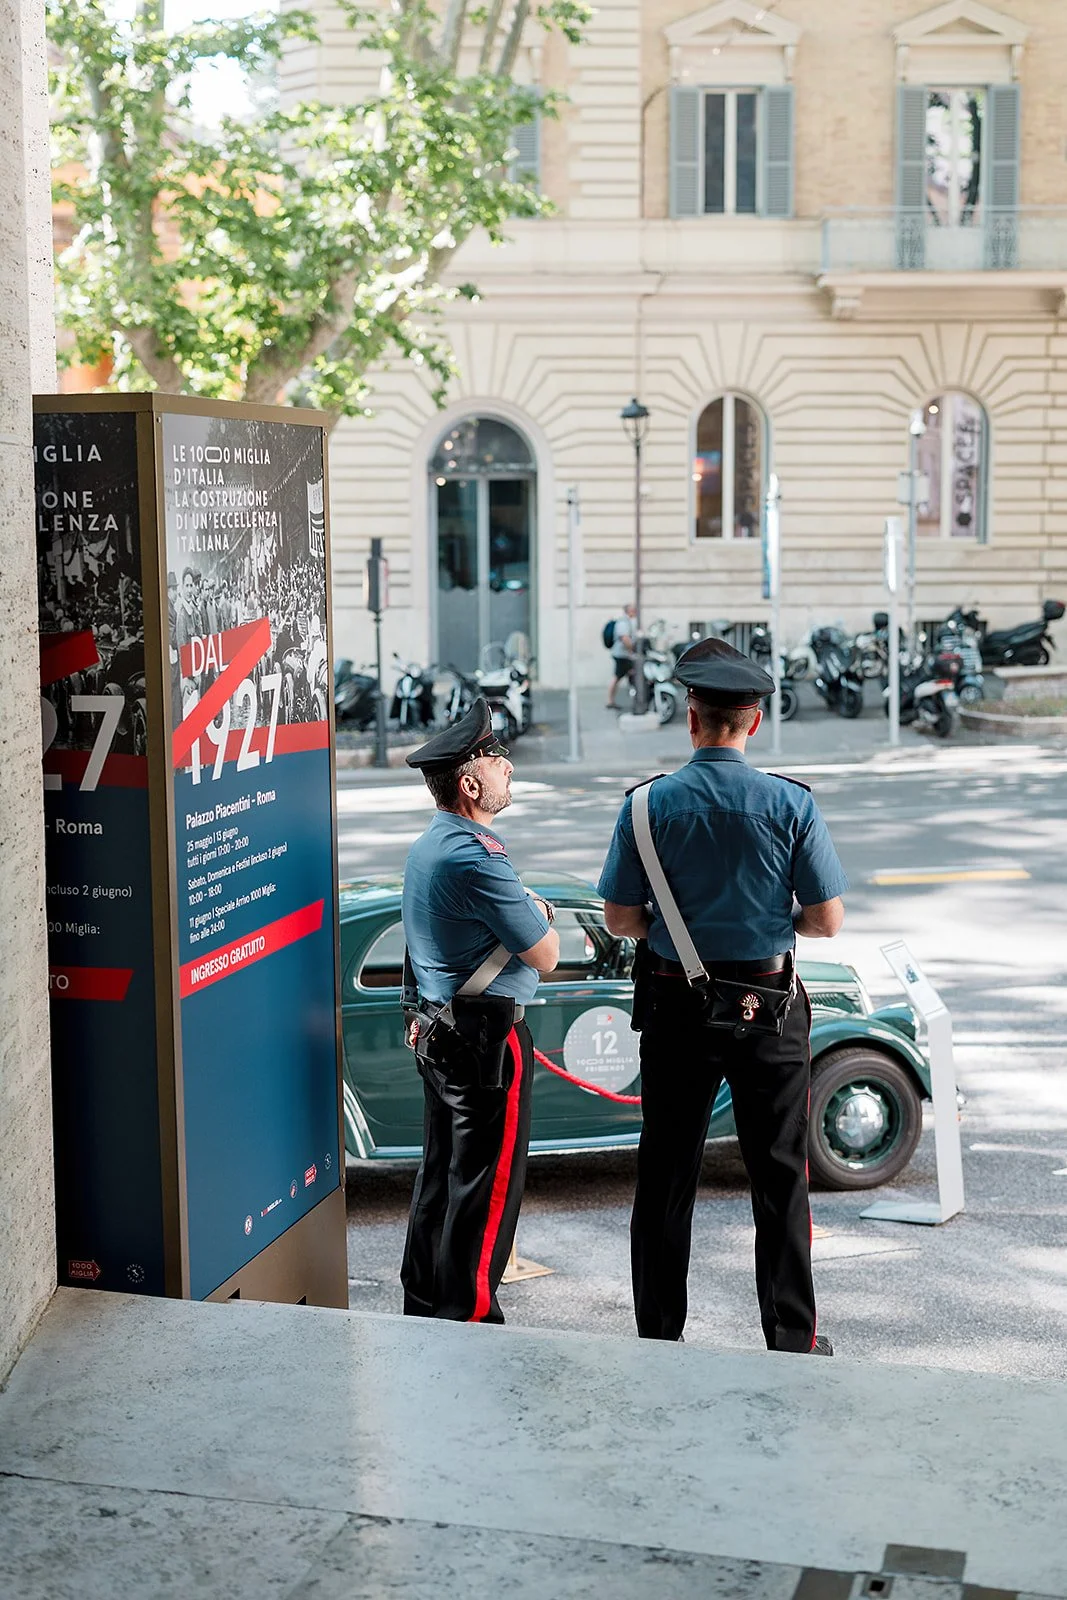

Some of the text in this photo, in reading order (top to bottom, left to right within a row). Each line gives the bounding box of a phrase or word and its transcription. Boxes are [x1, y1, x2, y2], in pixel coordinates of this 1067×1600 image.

[173, 445, 186, 463] LE
[235, 448, 271, 465] MIGLIA
[174, 468, 225, 485] D'ITALIA
[42, 491, 94, 508] ONE
[175, 490, 269, 508] LA COSTRUZIONE
[39, 514, 119, 531] LENZA
[176, 511, 278, 530] DI UN'ECCELLENZA
[177, 534, 230, 553] ITALIANA
[191, 633, 229, 677] DAL
[183, 673, 282, 786] 1927
[186, 809, 215, 830] Palazzo
[215, 794, 250, 820] Piacentini
[257, 790, 276, 806] Roma
[55, 819, 103, 835] Roma
[187, 854, 199, 868] tutti
[203, 848, 217, 865] giorni
[207, 866, 231, 882] Domenica
[232, 865, 235, 873] e
[82, 885, 89, 895] 2
[92, 885, 132, 899] giugno)
[215, 900, 235, 918] Speciale
[65, 923, 101, 936] Miglia:
[191, 936, 265, 985] INGRESSO GRATUITO
[592, 1030, 618, 1055] 12
[72, 1262, 92, 1270] 1000
